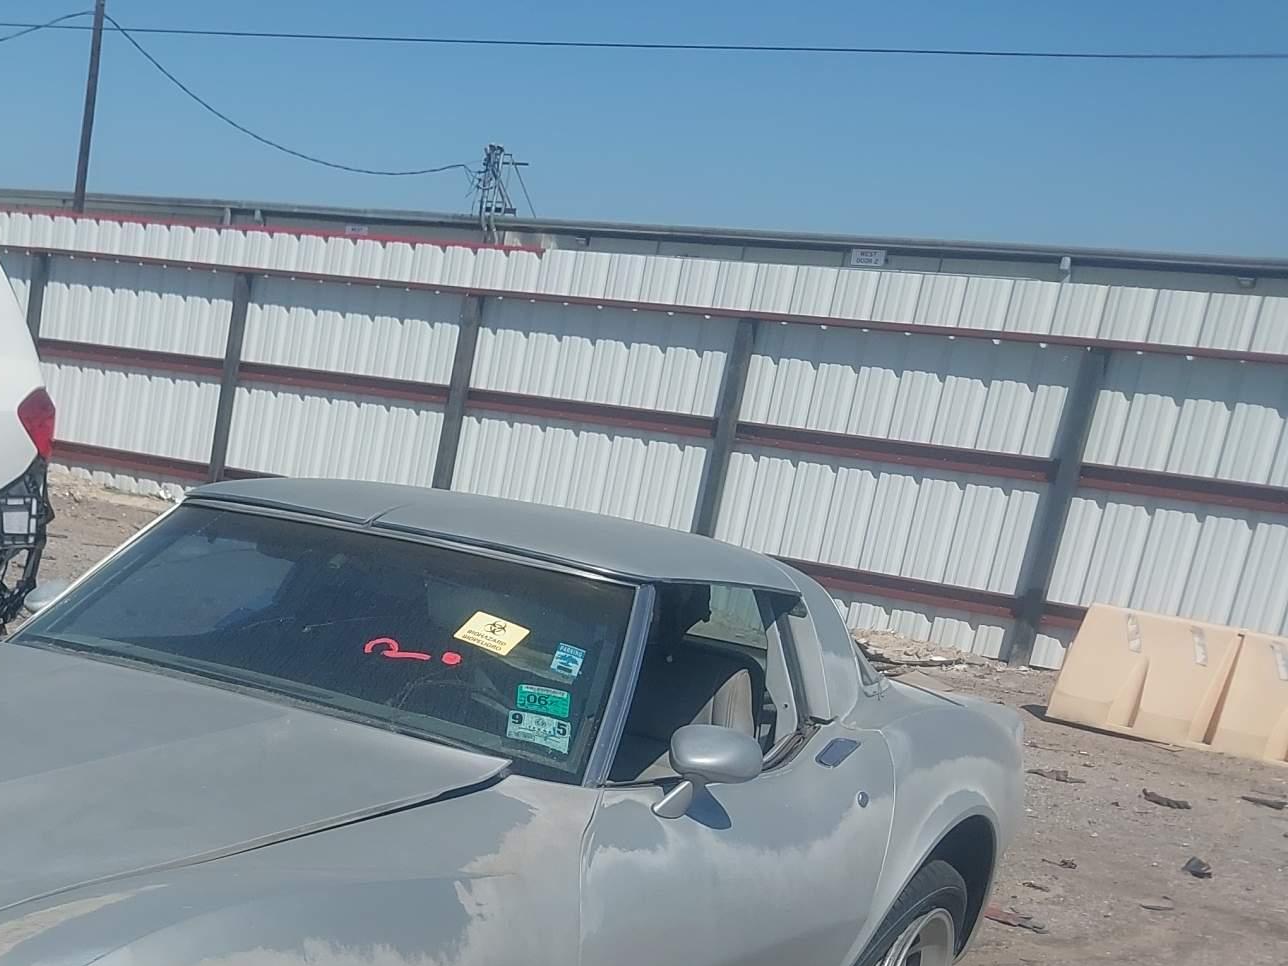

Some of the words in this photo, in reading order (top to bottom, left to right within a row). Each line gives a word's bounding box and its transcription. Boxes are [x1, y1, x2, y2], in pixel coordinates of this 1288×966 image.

[462, 634, 502, 652] BIOPELIGRO
[466, 629, 508, 647] BIOHAZARD
[526, 693, 549, 706] 06
[512, 712, 523, 725] 9
[556, 721, 567, 736] 5
